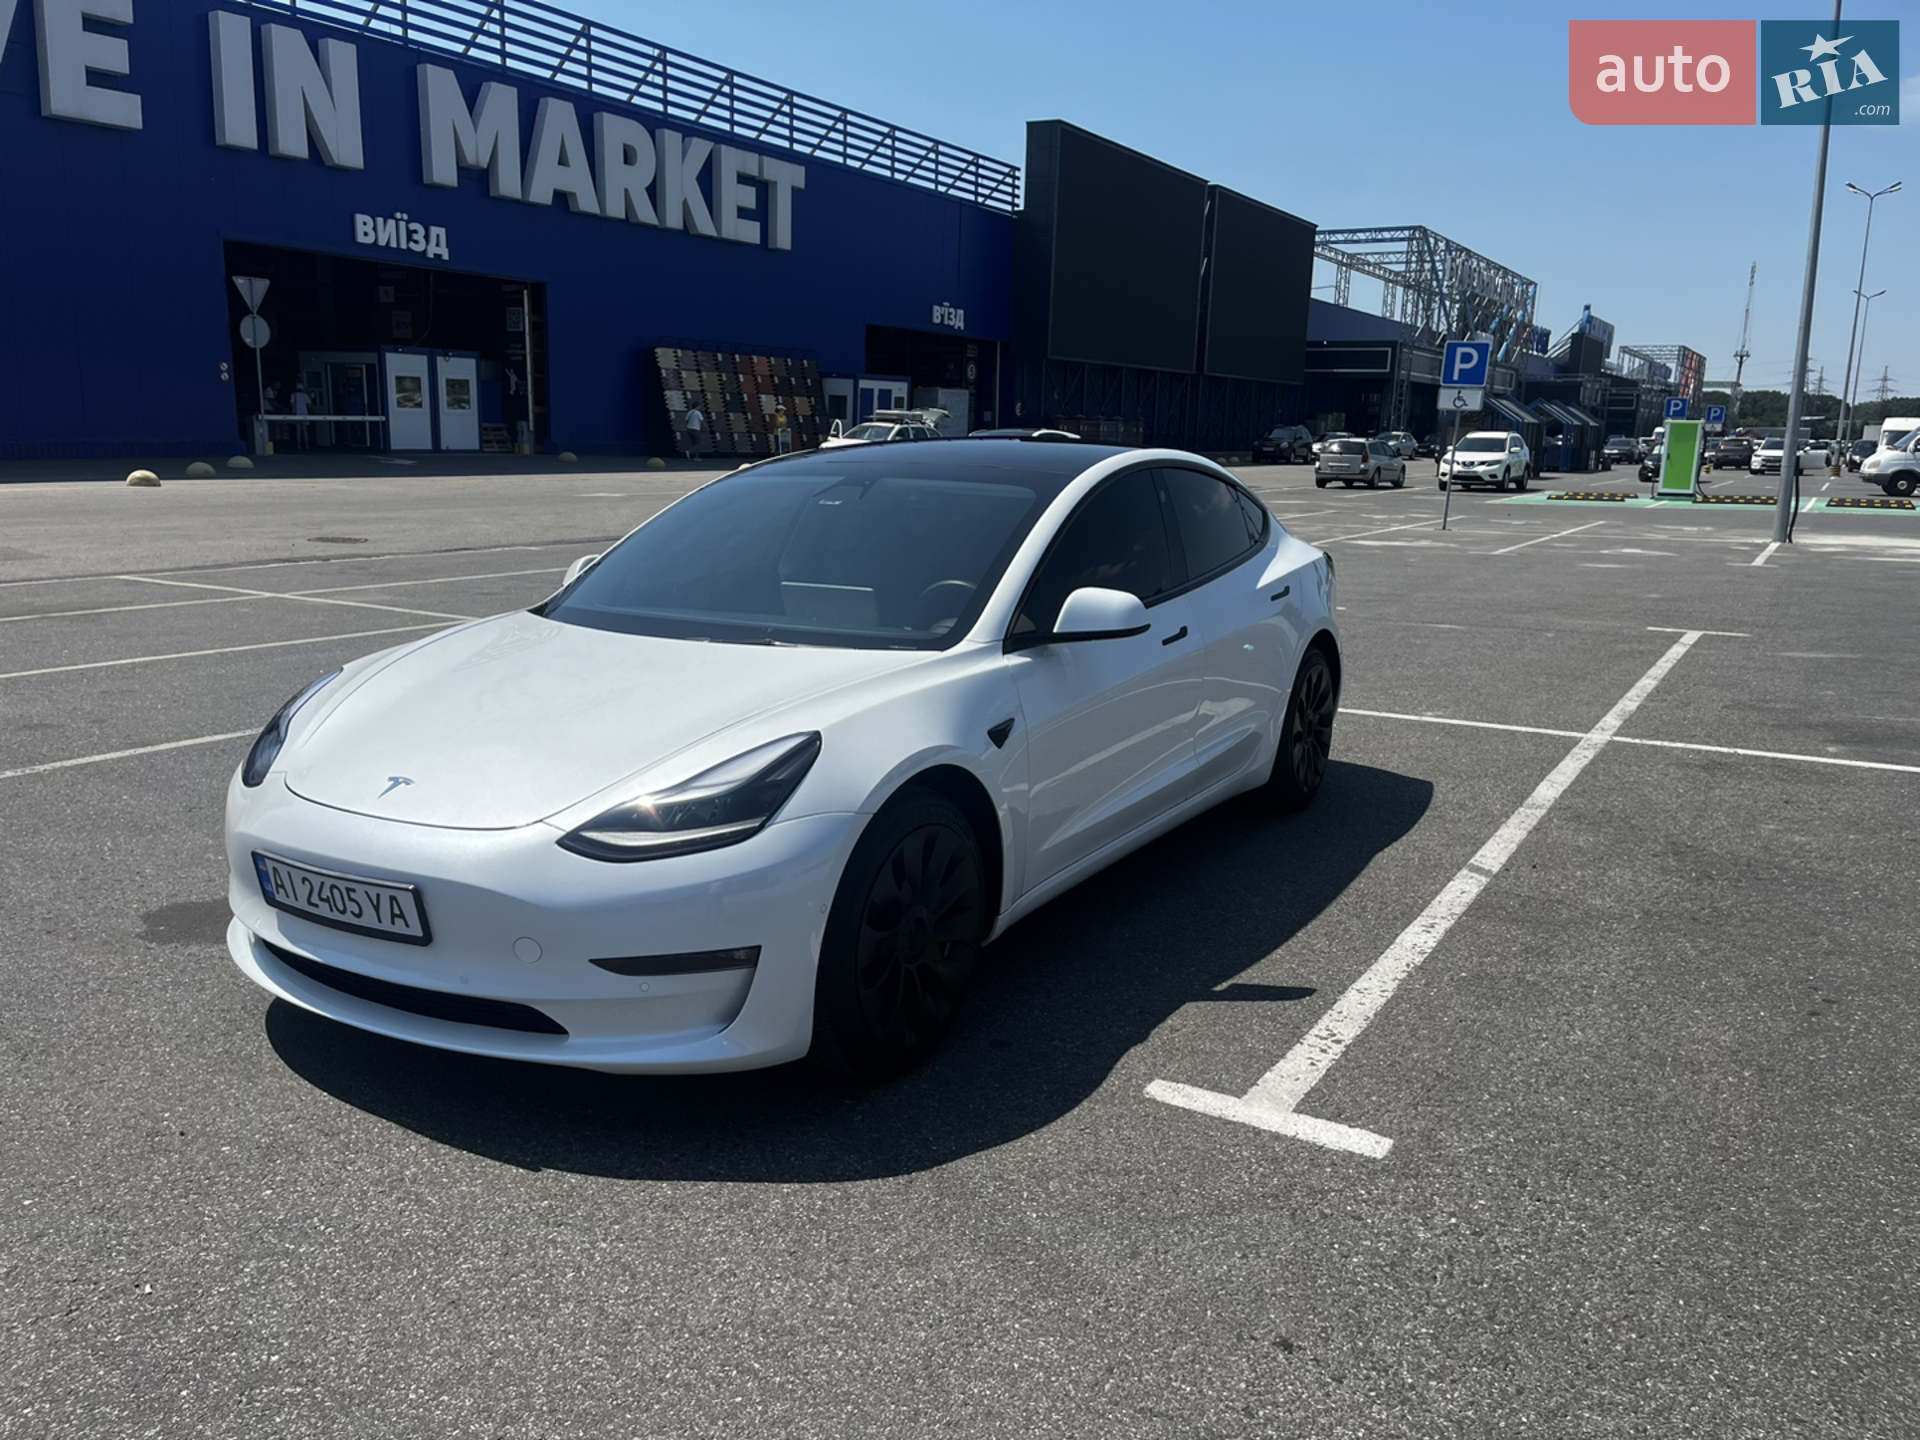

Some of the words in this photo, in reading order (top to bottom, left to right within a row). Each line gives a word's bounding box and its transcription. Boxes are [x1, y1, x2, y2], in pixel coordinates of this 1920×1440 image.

[0, 0, 143, 130] E
[208, 9, 365, 170] IN
[417, 62, 806, 252] MARKET
[353, 212, 450, 261] ВИЇЗД
[1453, 347, 1479, 381] P
[1669, 400, 1682, 415] P
[1710, 408, 1721, 421] P
